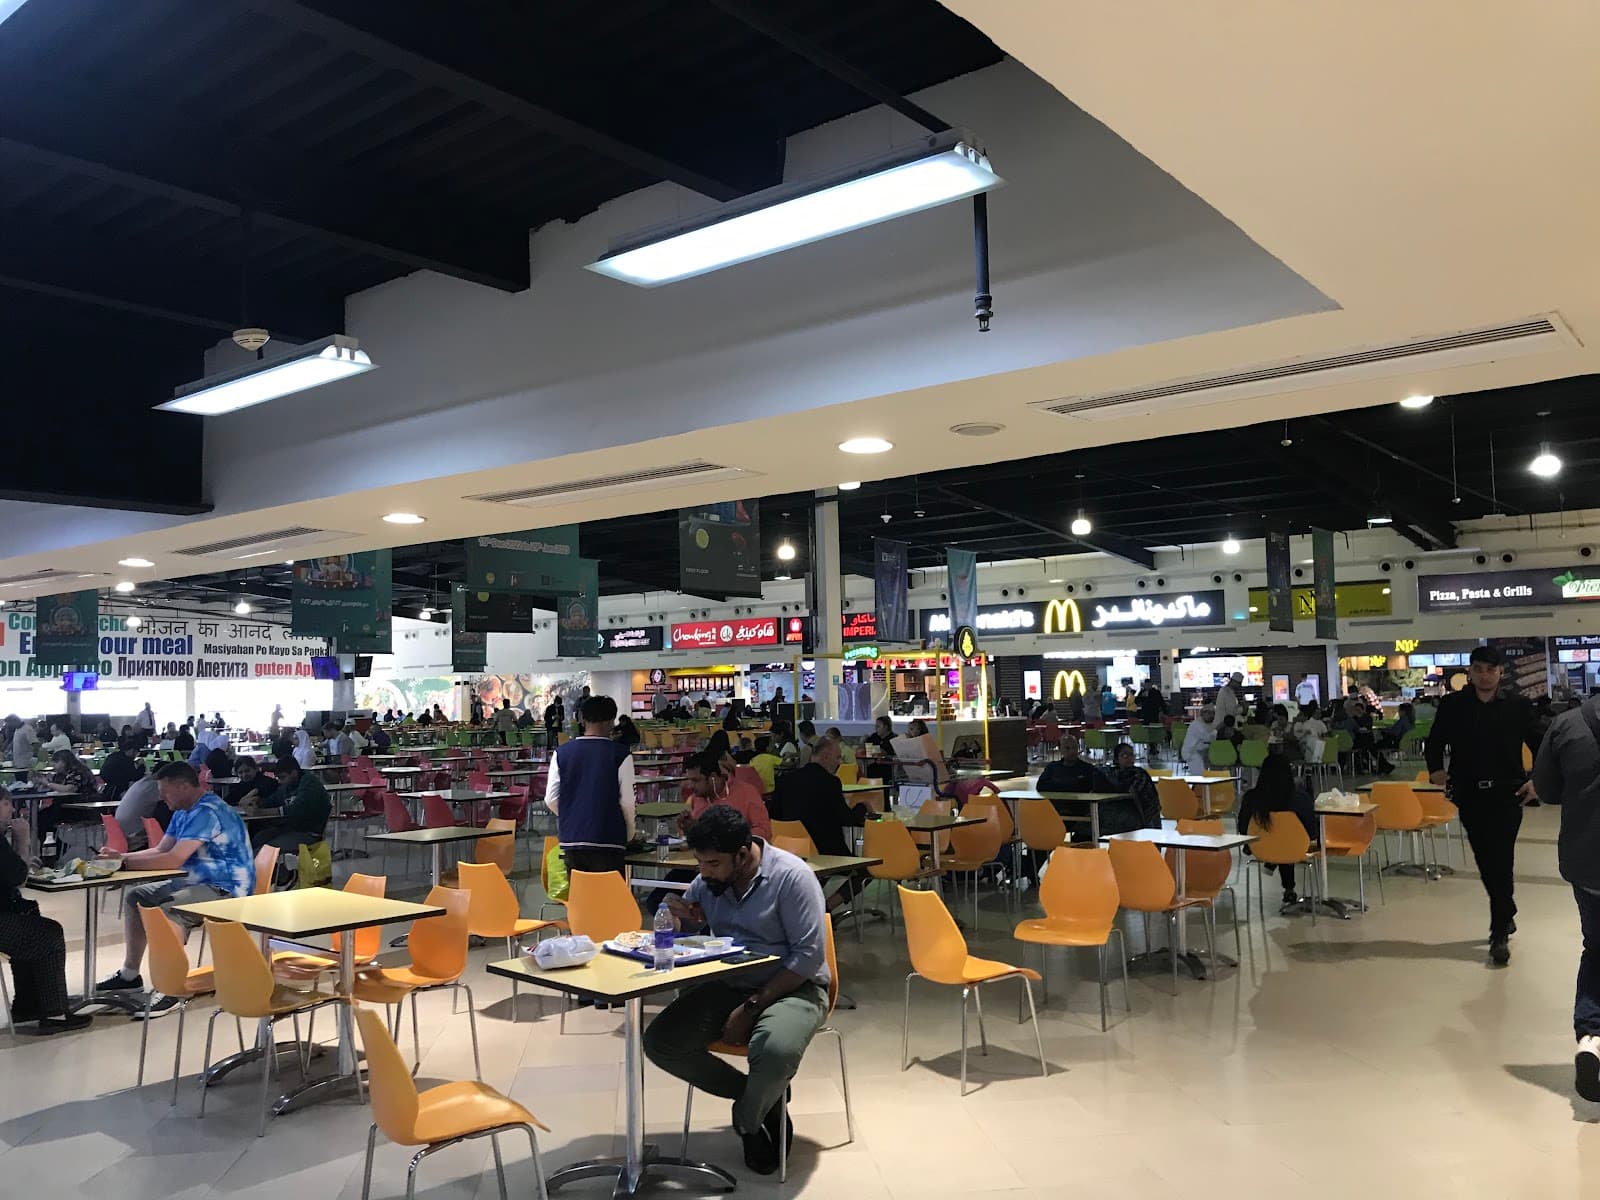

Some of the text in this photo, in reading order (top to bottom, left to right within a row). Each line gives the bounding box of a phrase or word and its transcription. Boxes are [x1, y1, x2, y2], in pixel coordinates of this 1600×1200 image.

[1429, 585, 1533, 602] Pizza, Pasta & Grills
[843, 625, 876, 637] IMPERI
[98, 635, 192, 655] our meal
[204, 643, 254, 655] Masiyahan
[256, 645, 267, 656] Po
[269, 646, 290, 657] Kayo
[292, 646, 303, 656] Sa
[197, 658, 249, 678] Апетита
[254, 662, 292, 677] guten
